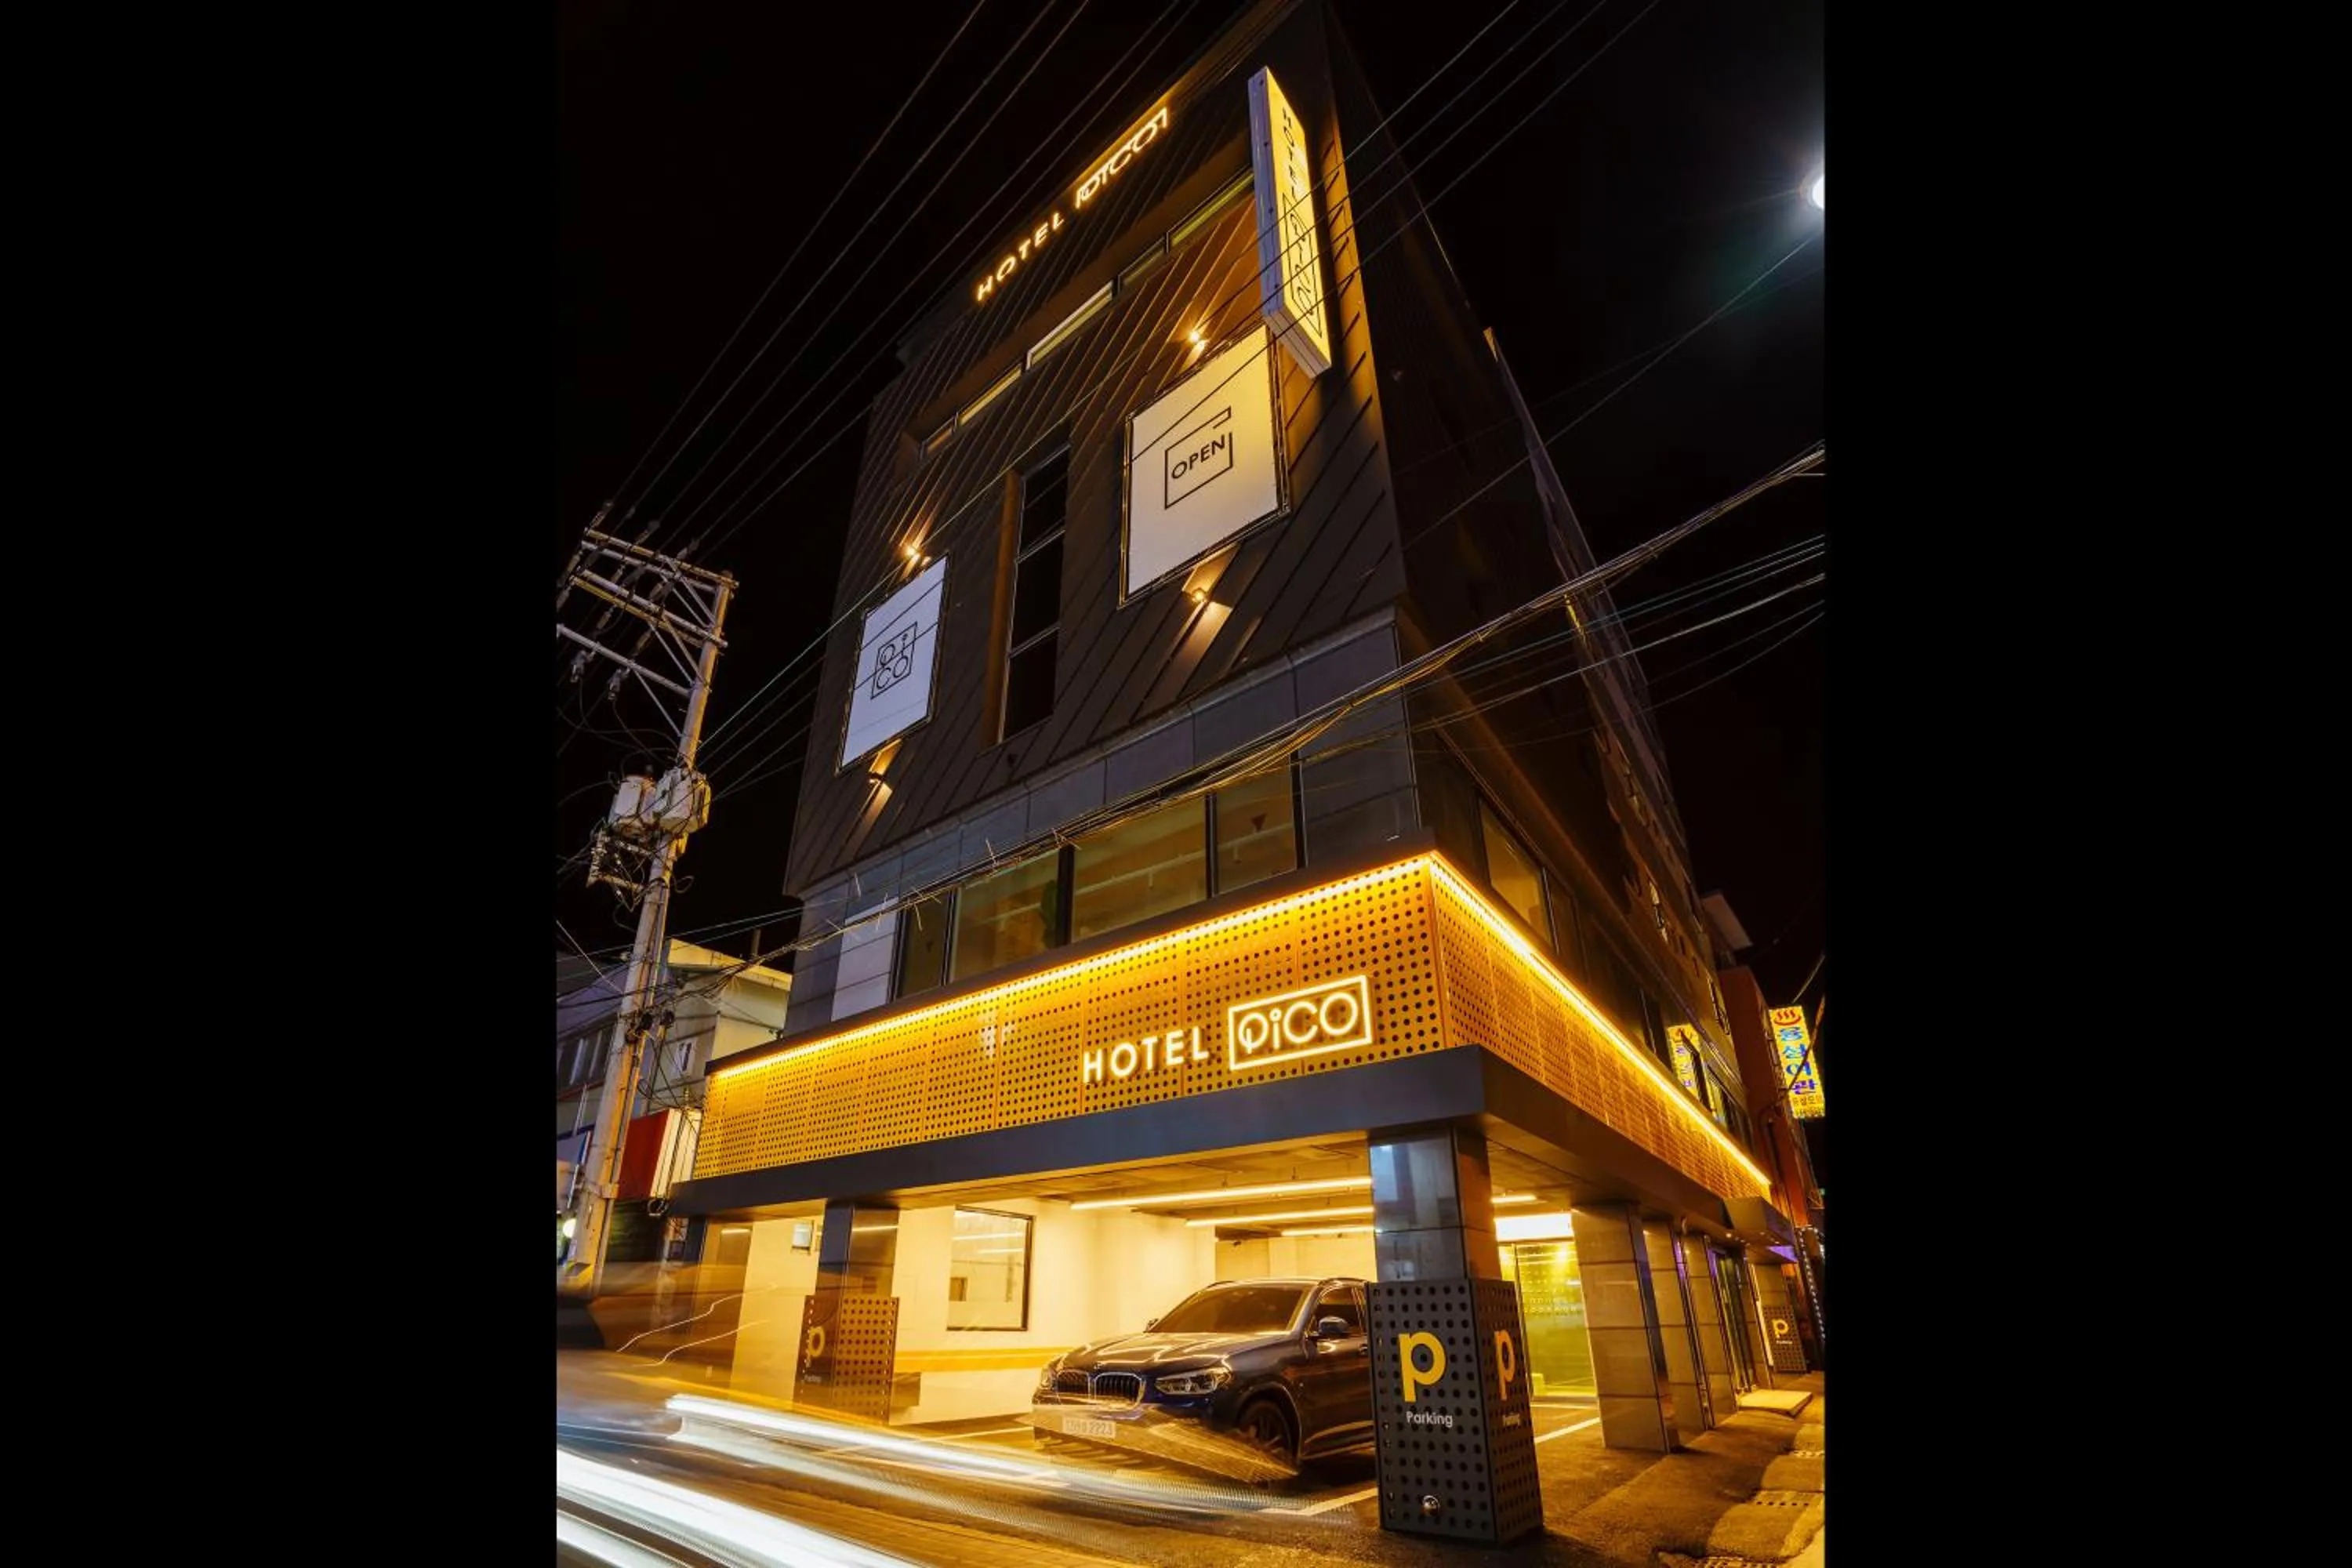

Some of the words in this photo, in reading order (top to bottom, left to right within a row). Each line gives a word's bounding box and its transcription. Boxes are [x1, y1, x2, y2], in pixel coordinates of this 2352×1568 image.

[978, 212, 1065, 301] HOTEL
[1171, 434, 1225, 479] OPEN
[1082, 1026, 1210, 1083] HOTEL
[1406, 1411, 1453, 1428] Parking
